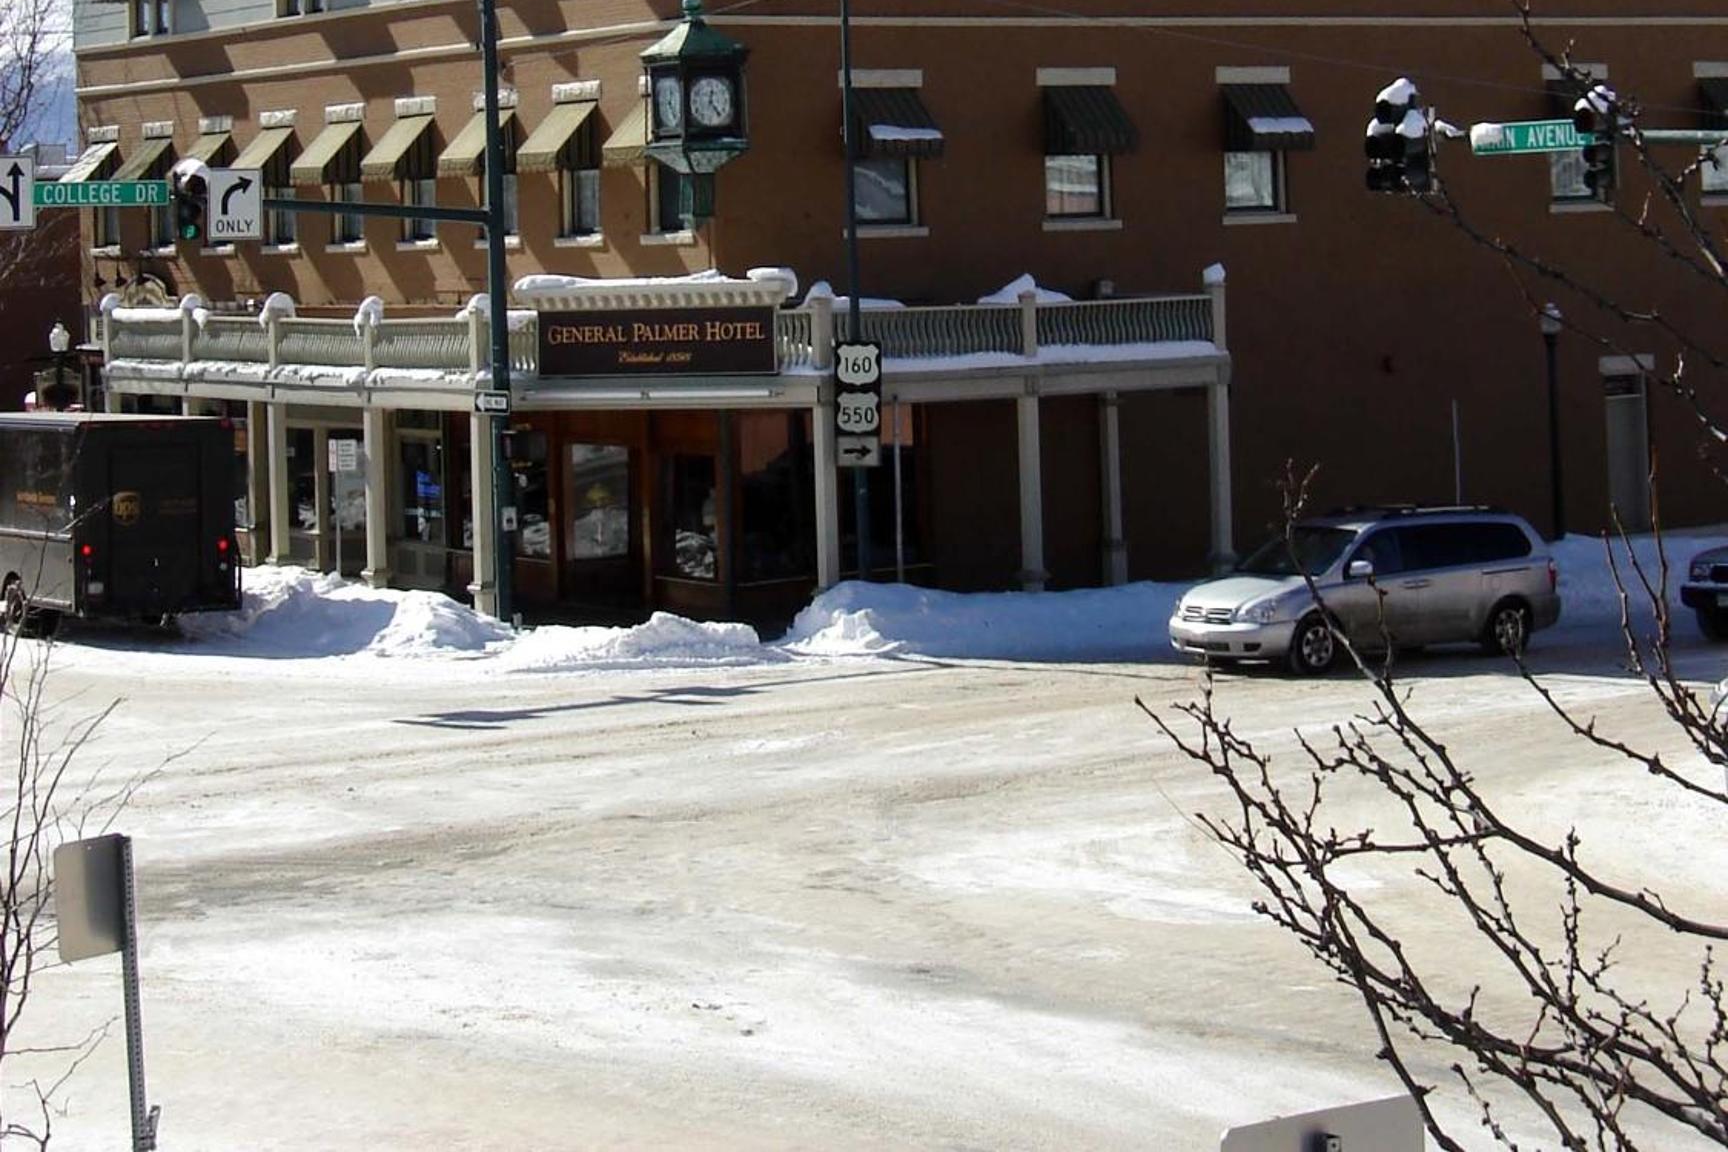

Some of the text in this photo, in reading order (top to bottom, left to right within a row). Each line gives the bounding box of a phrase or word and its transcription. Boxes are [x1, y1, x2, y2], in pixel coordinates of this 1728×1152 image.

[43, 184, 158, 204] COLLEGE DR
[215, 219, 254, 234] ONLY
[548, 321, 766, 345] GENERAL PALMER HOTEL
[844, 356, 873, 374] 160
[842, 406, 875, 424] 550
